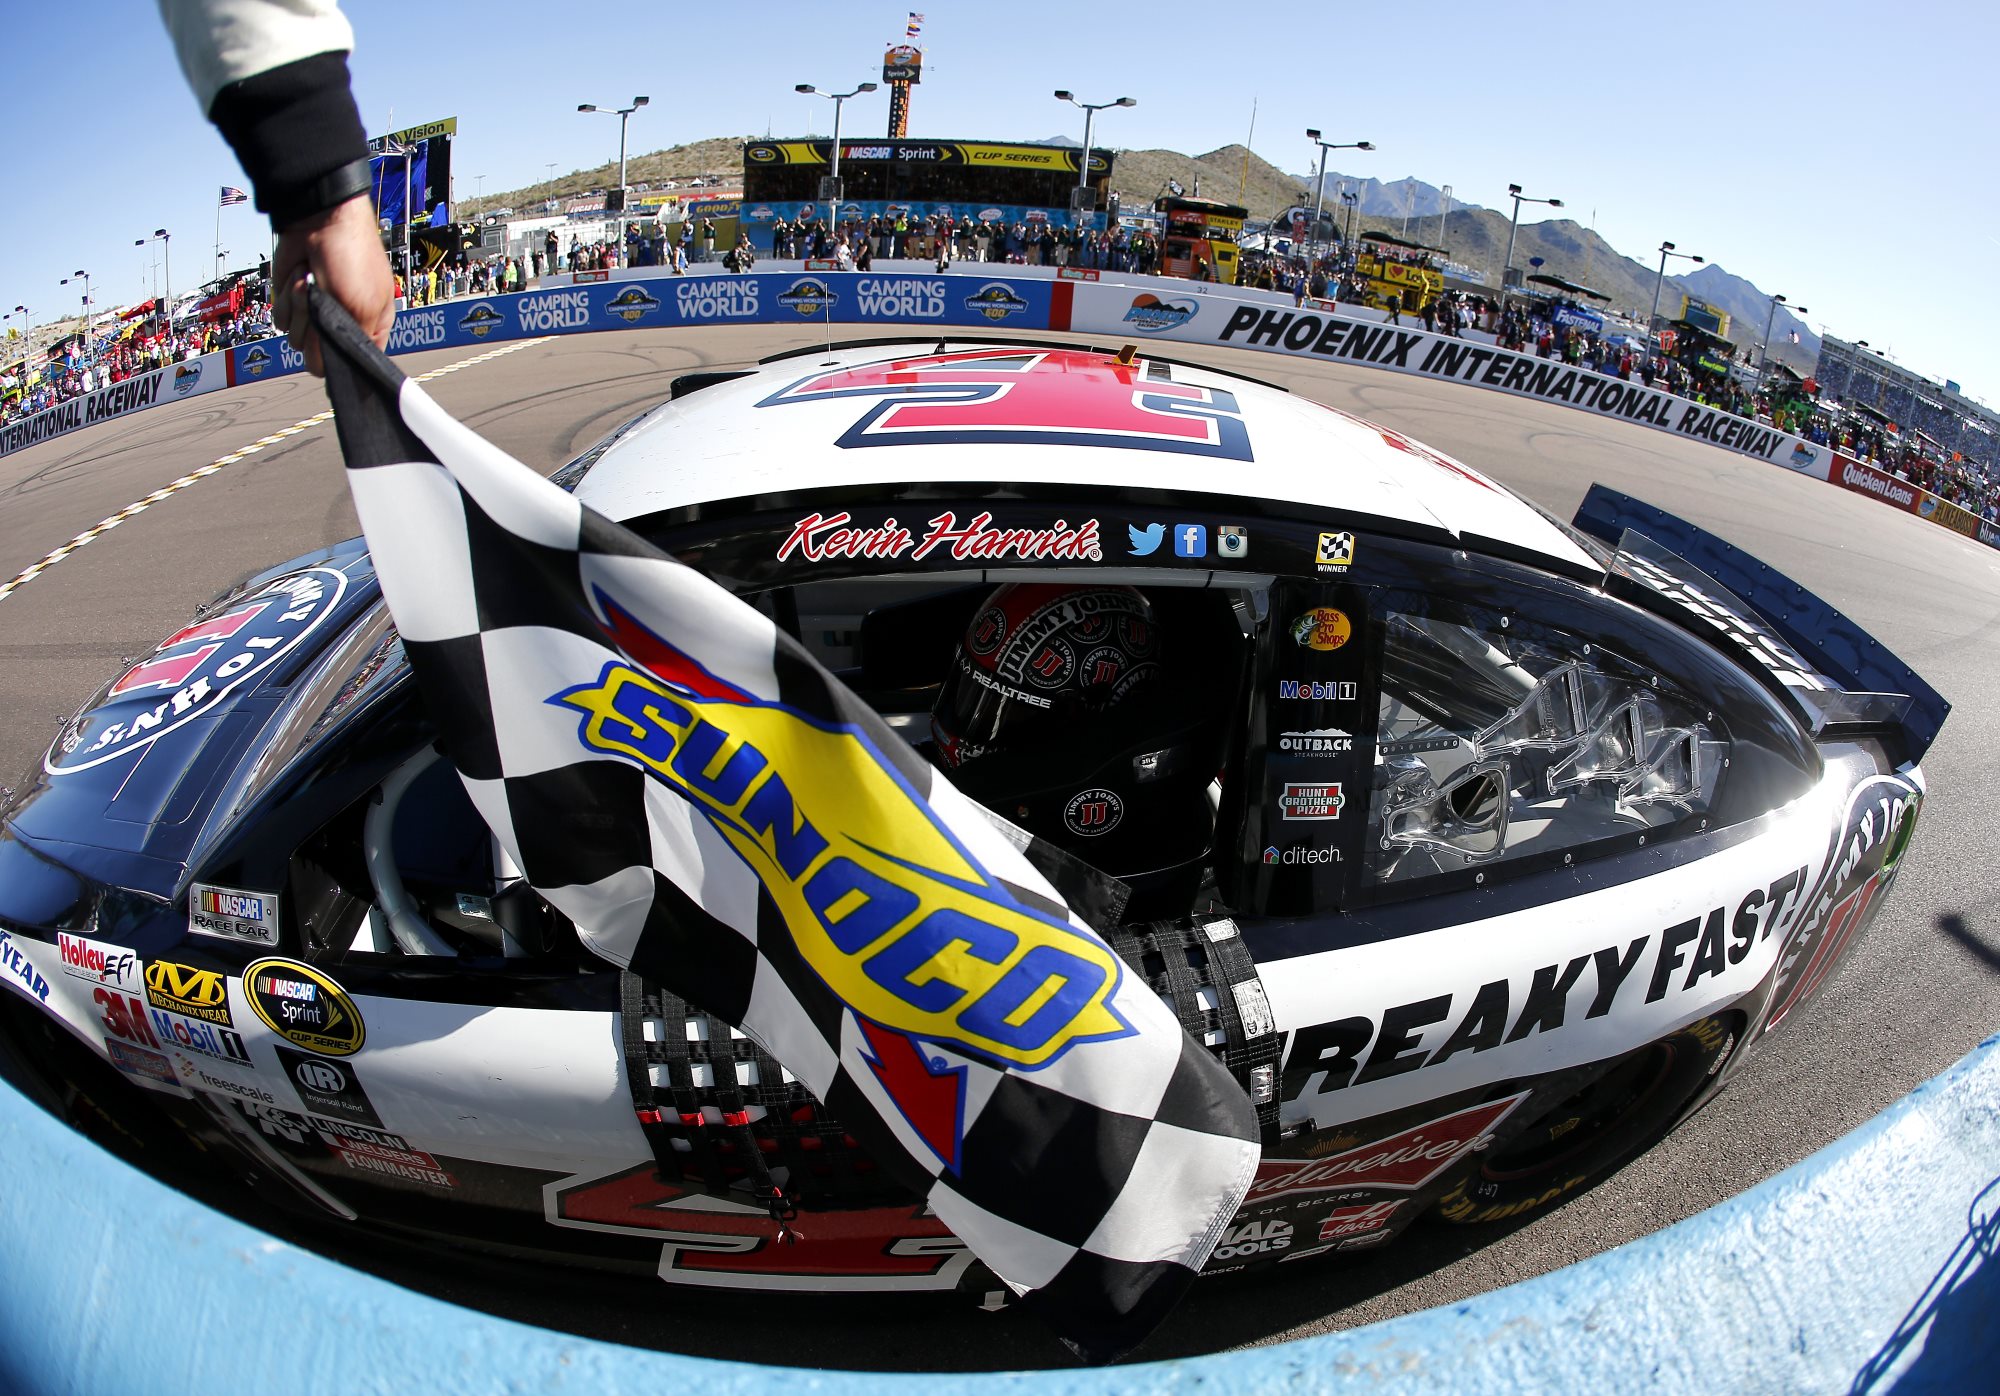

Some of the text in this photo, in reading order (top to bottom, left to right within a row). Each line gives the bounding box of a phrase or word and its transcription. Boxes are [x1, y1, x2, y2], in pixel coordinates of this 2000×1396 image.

[403, 122, 445, 141] Vision
[848, 146, 1052, 164] NASCAR Sprint CUP SERIES
[570, 204, 592, 214] LUCAS
[677, 280, 759, 299] CAMPING
[857, 278, 946, 297] CAMPING
[517, 291, 589, 314] CAMPING
[678, 298, 759, 319] WORLD
[857, 296, 946, 318] WORLD
[391, 309, 445, 333] AMPING
[519, 307, 590, 332] WORLD
[1555, 309, 1601, 333] FASTENAL
[388, 325, 446, 350] WORLD
[1218, 305, 1785, 459] PHOENIX INTERNATIONAL RACEWAY
[85, 372, 163, 423] RACEWAY
[776, 511, 910, 562] Kevin
[1317, 564, 1348, 573] WINNER
[1315, 609, 1340, 622] Bass
[1316, 621, 1335, 633] Pro
[1315, 631, 1345, 647] Shops
[1084, 649, 1109, 671] JIMMY
[971, 669, 1053, 709] REALTREE
[1280, 680, 1337, 700] Mobil
[1280, 738, 1352, 751] OUTBACK
[1068, 791, 1120, 816] JIMMY JOHN'S
[1285, 796, 1340, 806] BROTHERS
[1298, 788, 1329, 797] HUNT
[1080, 801, 1108, 826] JJ
[1296, 805, 1328, 815] PIZZA
[1282, 844, 1341, 865] ditech
[597, 680, 1104, 1053] SUNOCO
[218, 893, 263, 921] NASCAR
[194, 914, 271, 941] RACE CAR
[59, 934, 134, 985] Holley EFI
[274, 978, 317, 1002] NASCAR
[93, 986, 162, 1050] 3M
[148, 988, 231, 1025] MECHANIX WEAR
[281, 1000, 321, 1024] Sprint
[150, 1008, 222, 1054] Mobil
[290, 1031, 352, 1050] CUP SERIES
[198, 1070, 274, 1104] freescale
[307, 1092, 364, 1113] Ingersoll Rand
[314, 1117, 405, 1150] LINCOLN
[345, 1138, 428, 1165] WELDERS
[344, 1150, 452, 1187] FLOWMASTER
[1296, 1191, 1364, 1209] BEERS
[1212, 1237, 1291, 1260] OOLS
